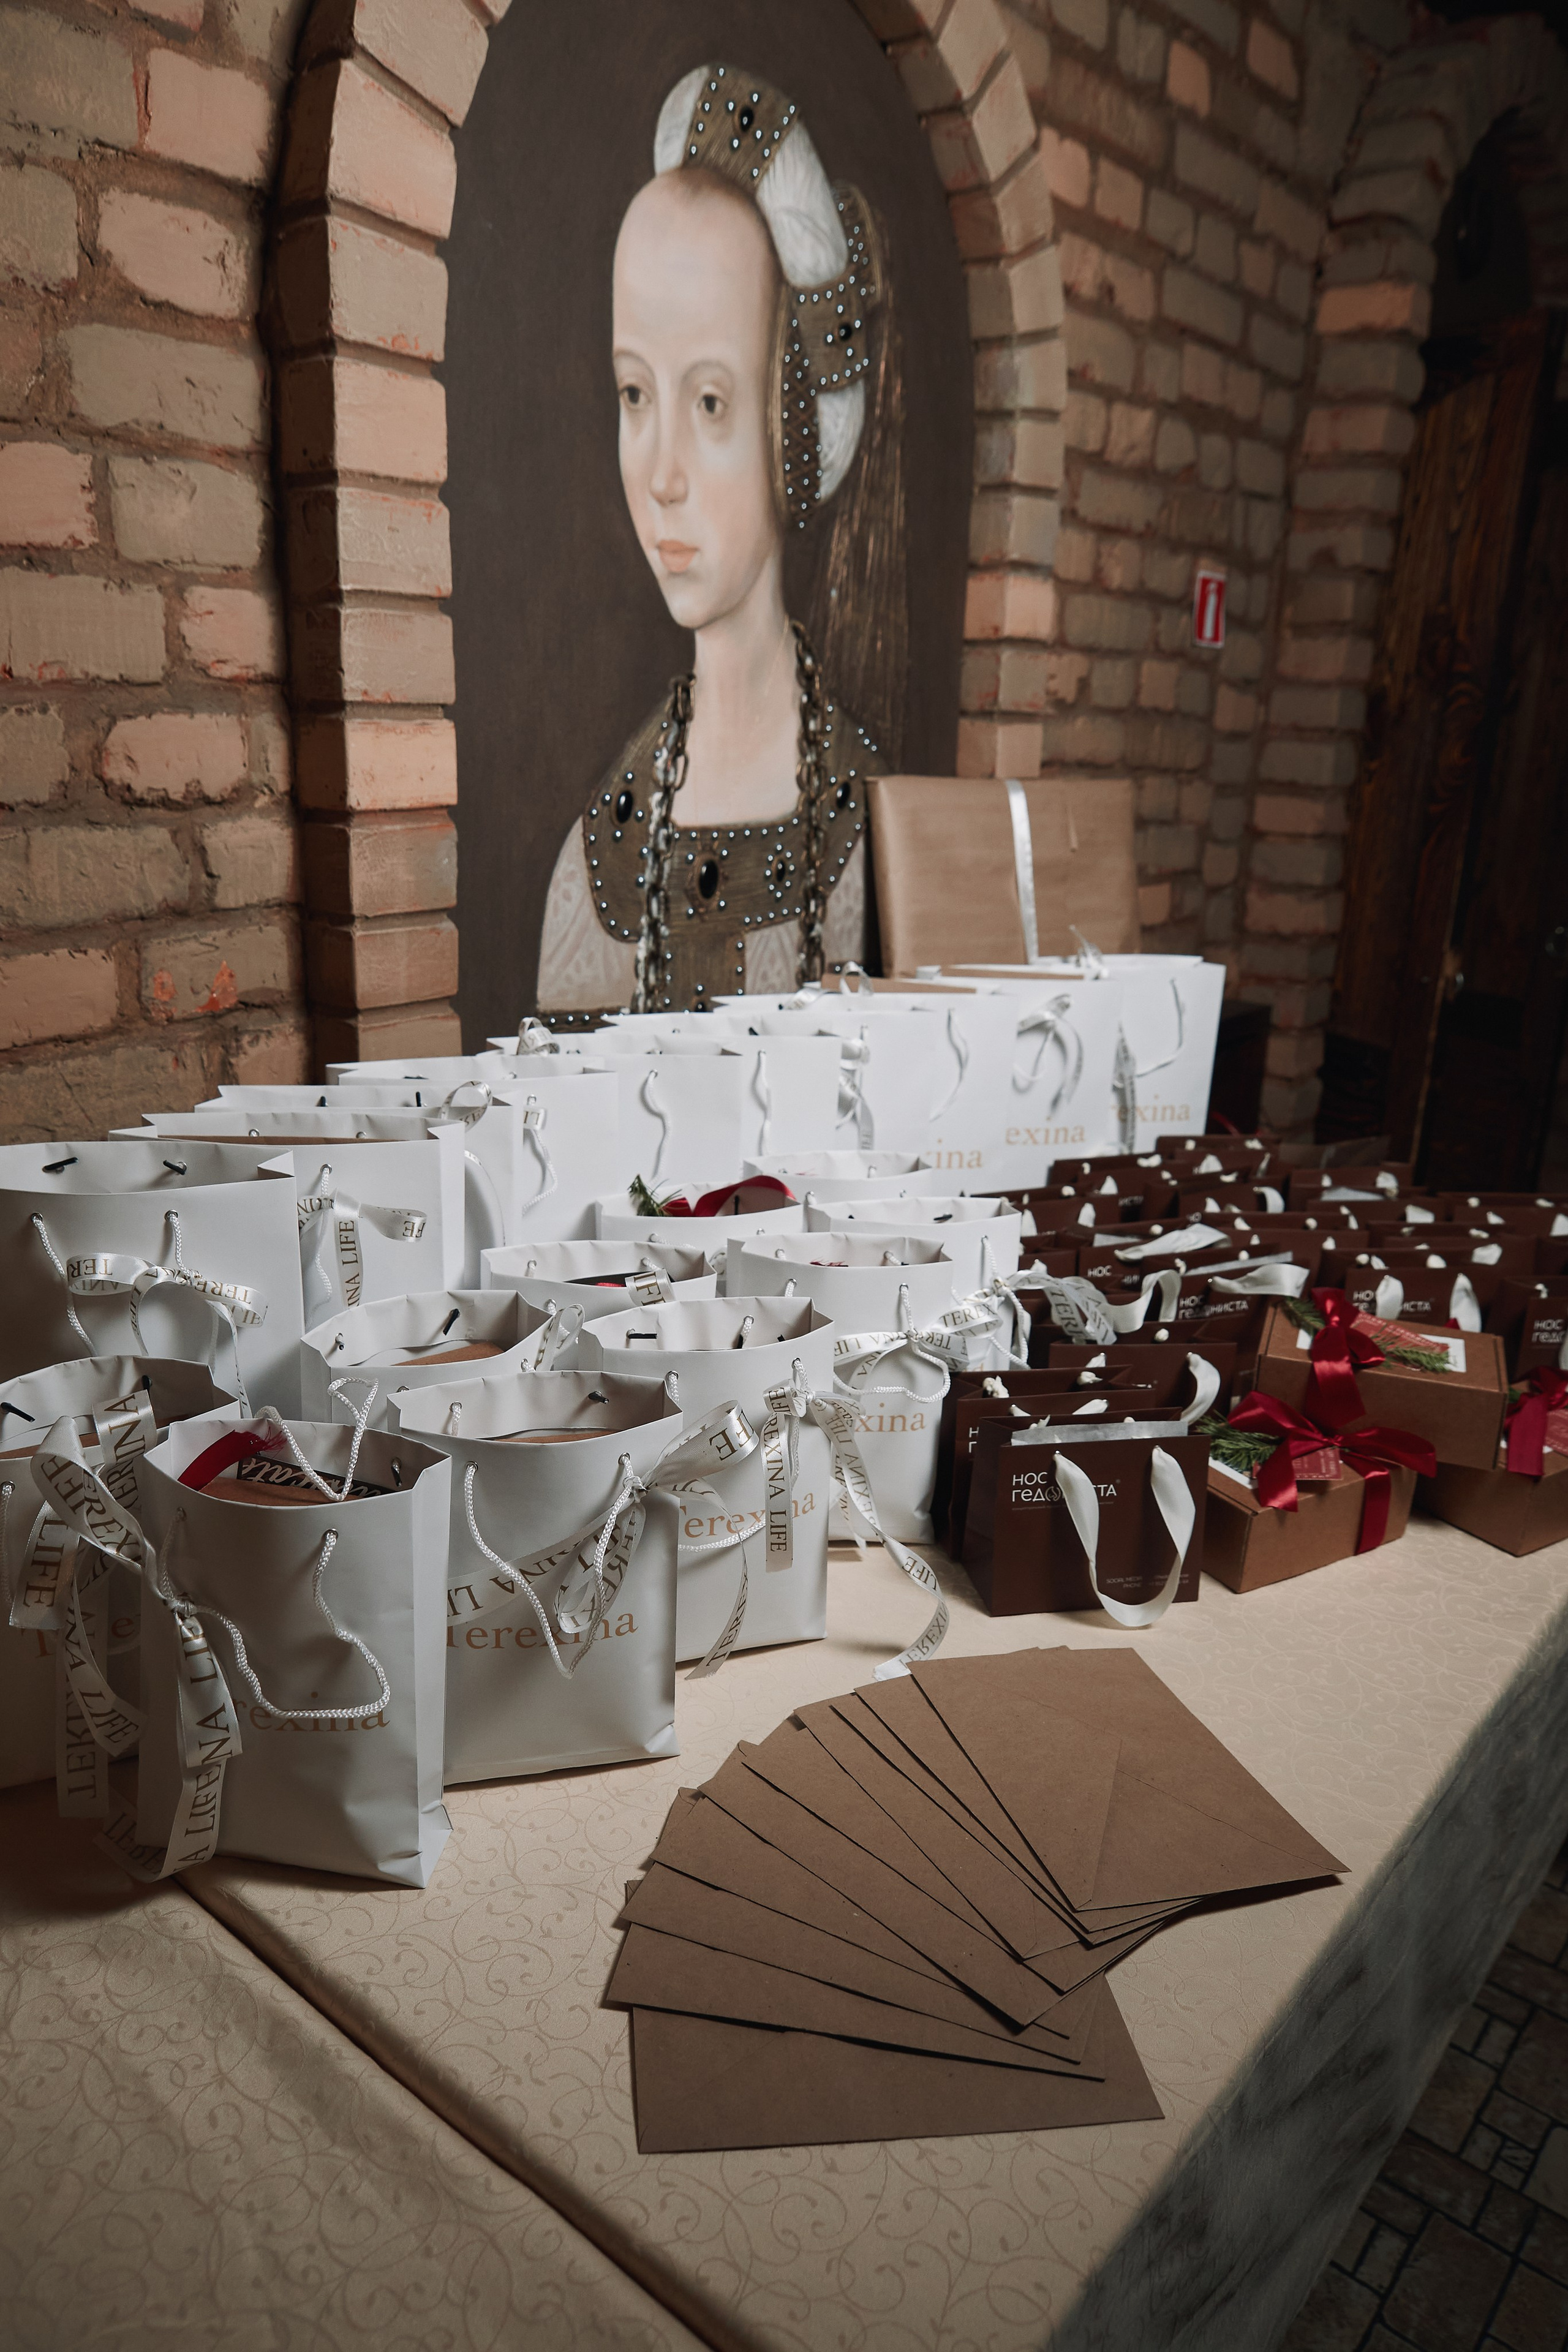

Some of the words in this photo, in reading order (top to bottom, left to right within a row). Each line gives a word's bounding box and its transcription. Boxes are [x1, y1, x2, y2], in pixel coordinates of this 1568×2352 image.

[339, 1220, 359, 1266] LIFE
[1012, 1472, 1048, 1486] НОС
[769, 1510, 788, 1553] LIFE
[23, 1516, 69, 1607] LIFE
[902, 1556, 938, 1591] LIFE
